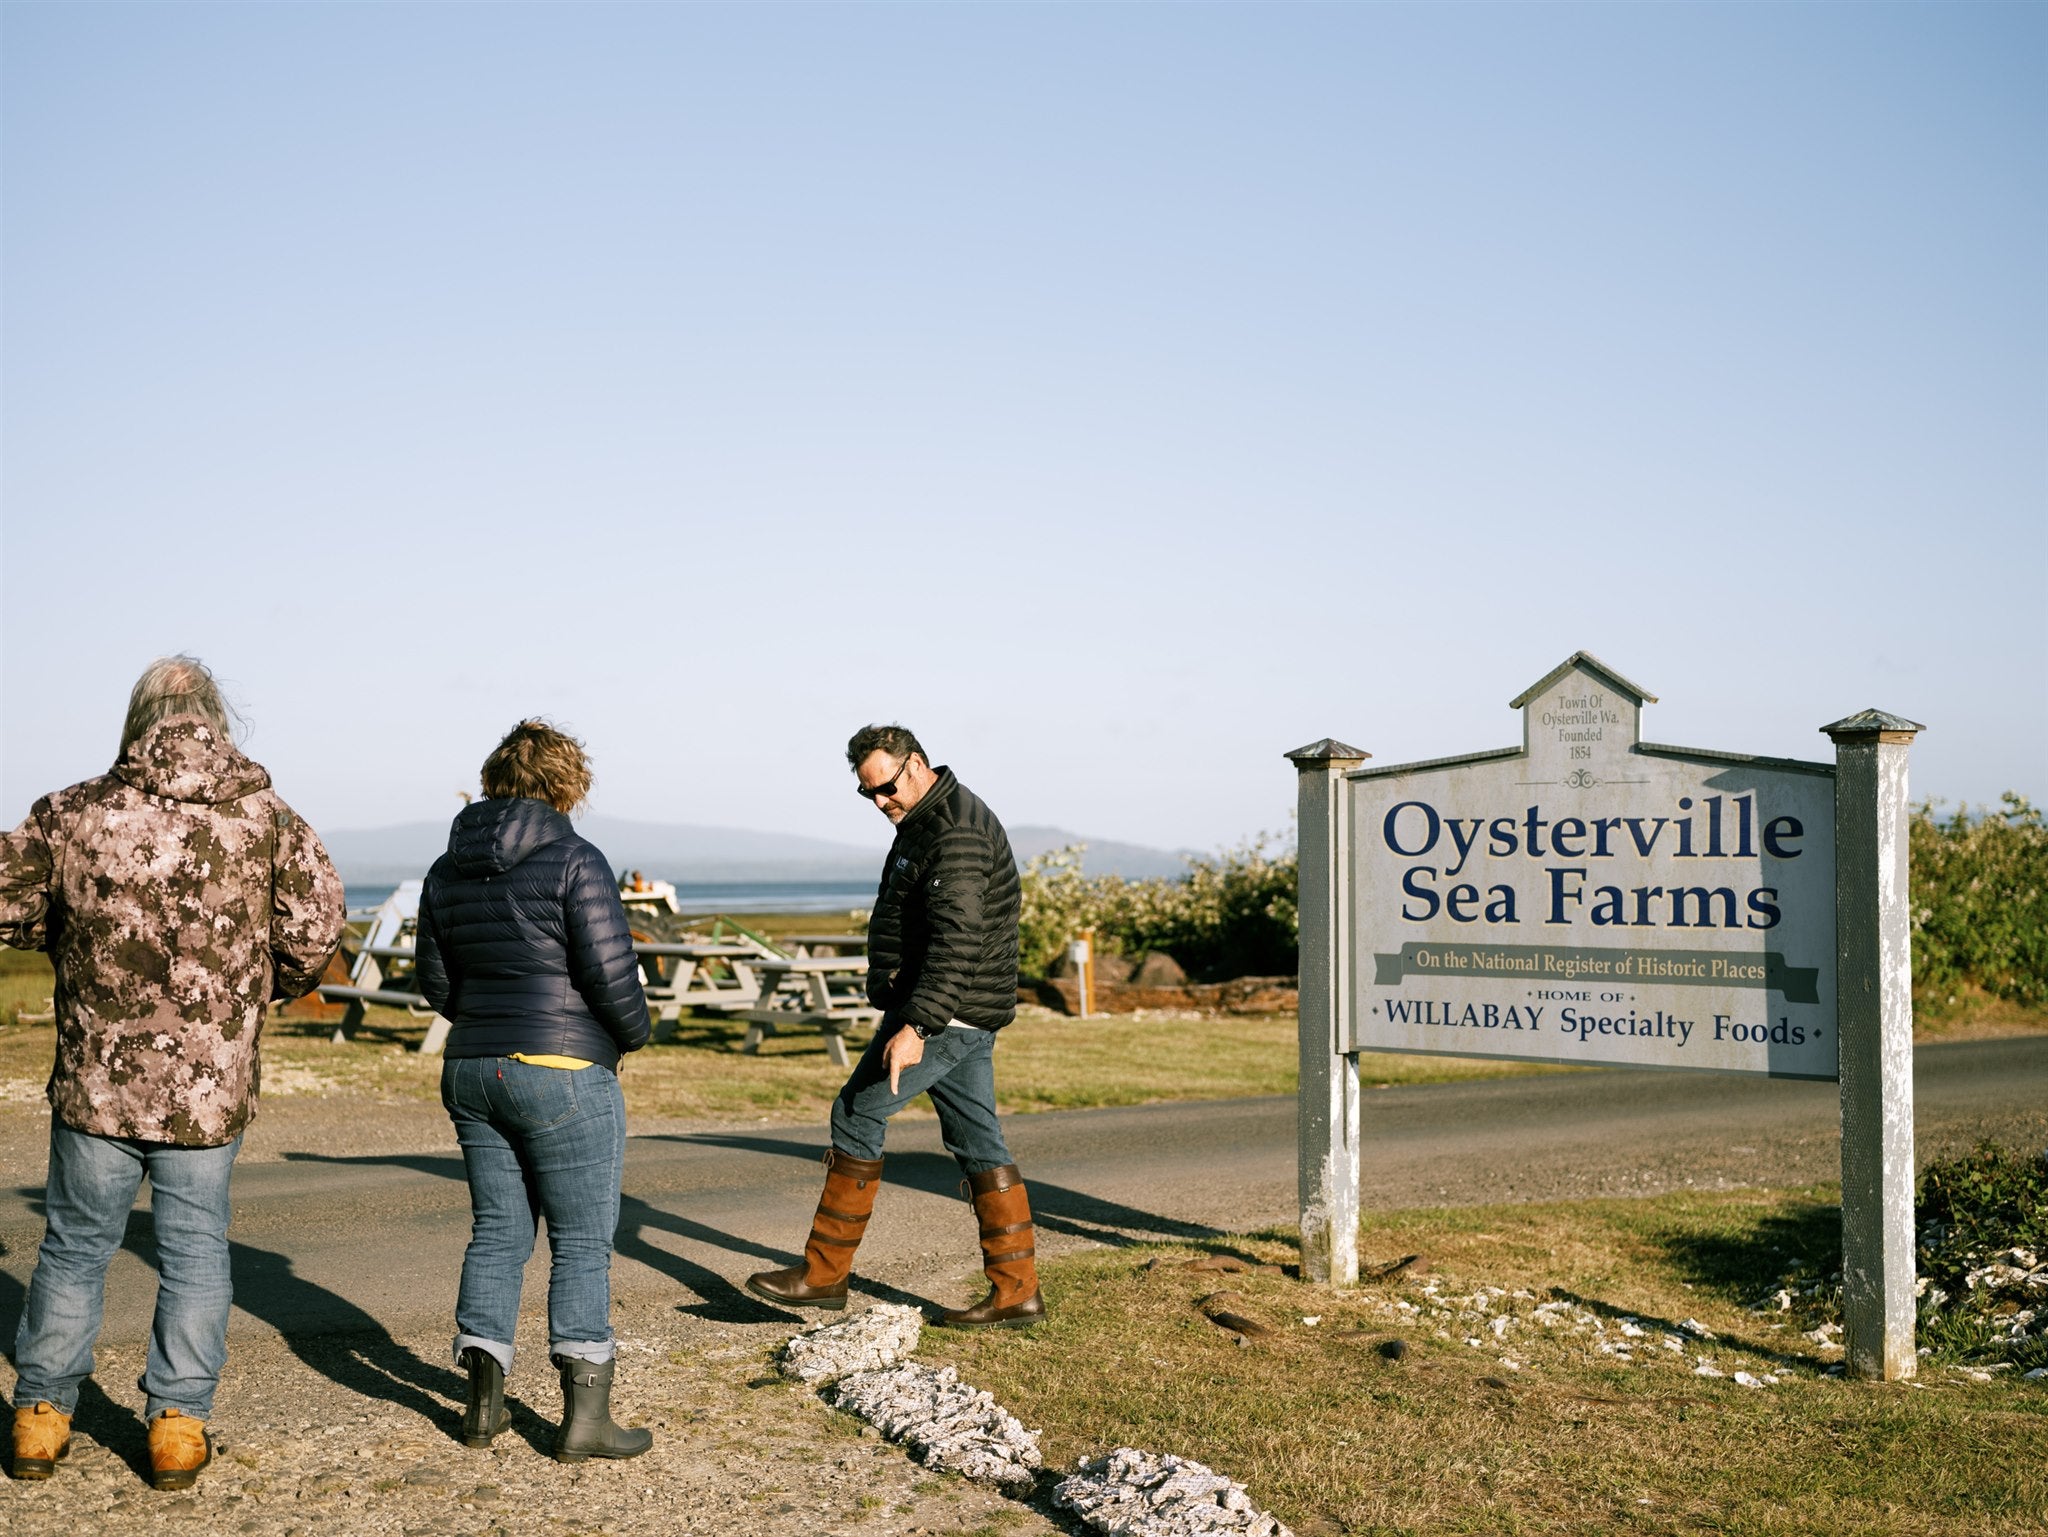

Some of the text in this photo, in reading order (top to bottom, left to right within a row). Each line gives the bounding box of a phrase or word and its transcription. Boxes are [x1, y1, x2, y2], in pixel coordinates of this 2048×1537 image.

[1558, 694, 1604, 710] Town Of
[1542, 711, 1620, 730] Oysterville Wa.
[1559, 728, 1602, 742] Founded
[1569, 746, 1591, 760] 1854
[1383, 794, 1805, 877] Oysterville
[1401, 865, 1782, 930] Sea Farms
[1416, 950, 1766, 980] On the National Register of Historic Places
[1537, 990, 1625, 1003] HOME OF
[1385, 999, 1806, 1047] WILLABAY Specialty Foods
